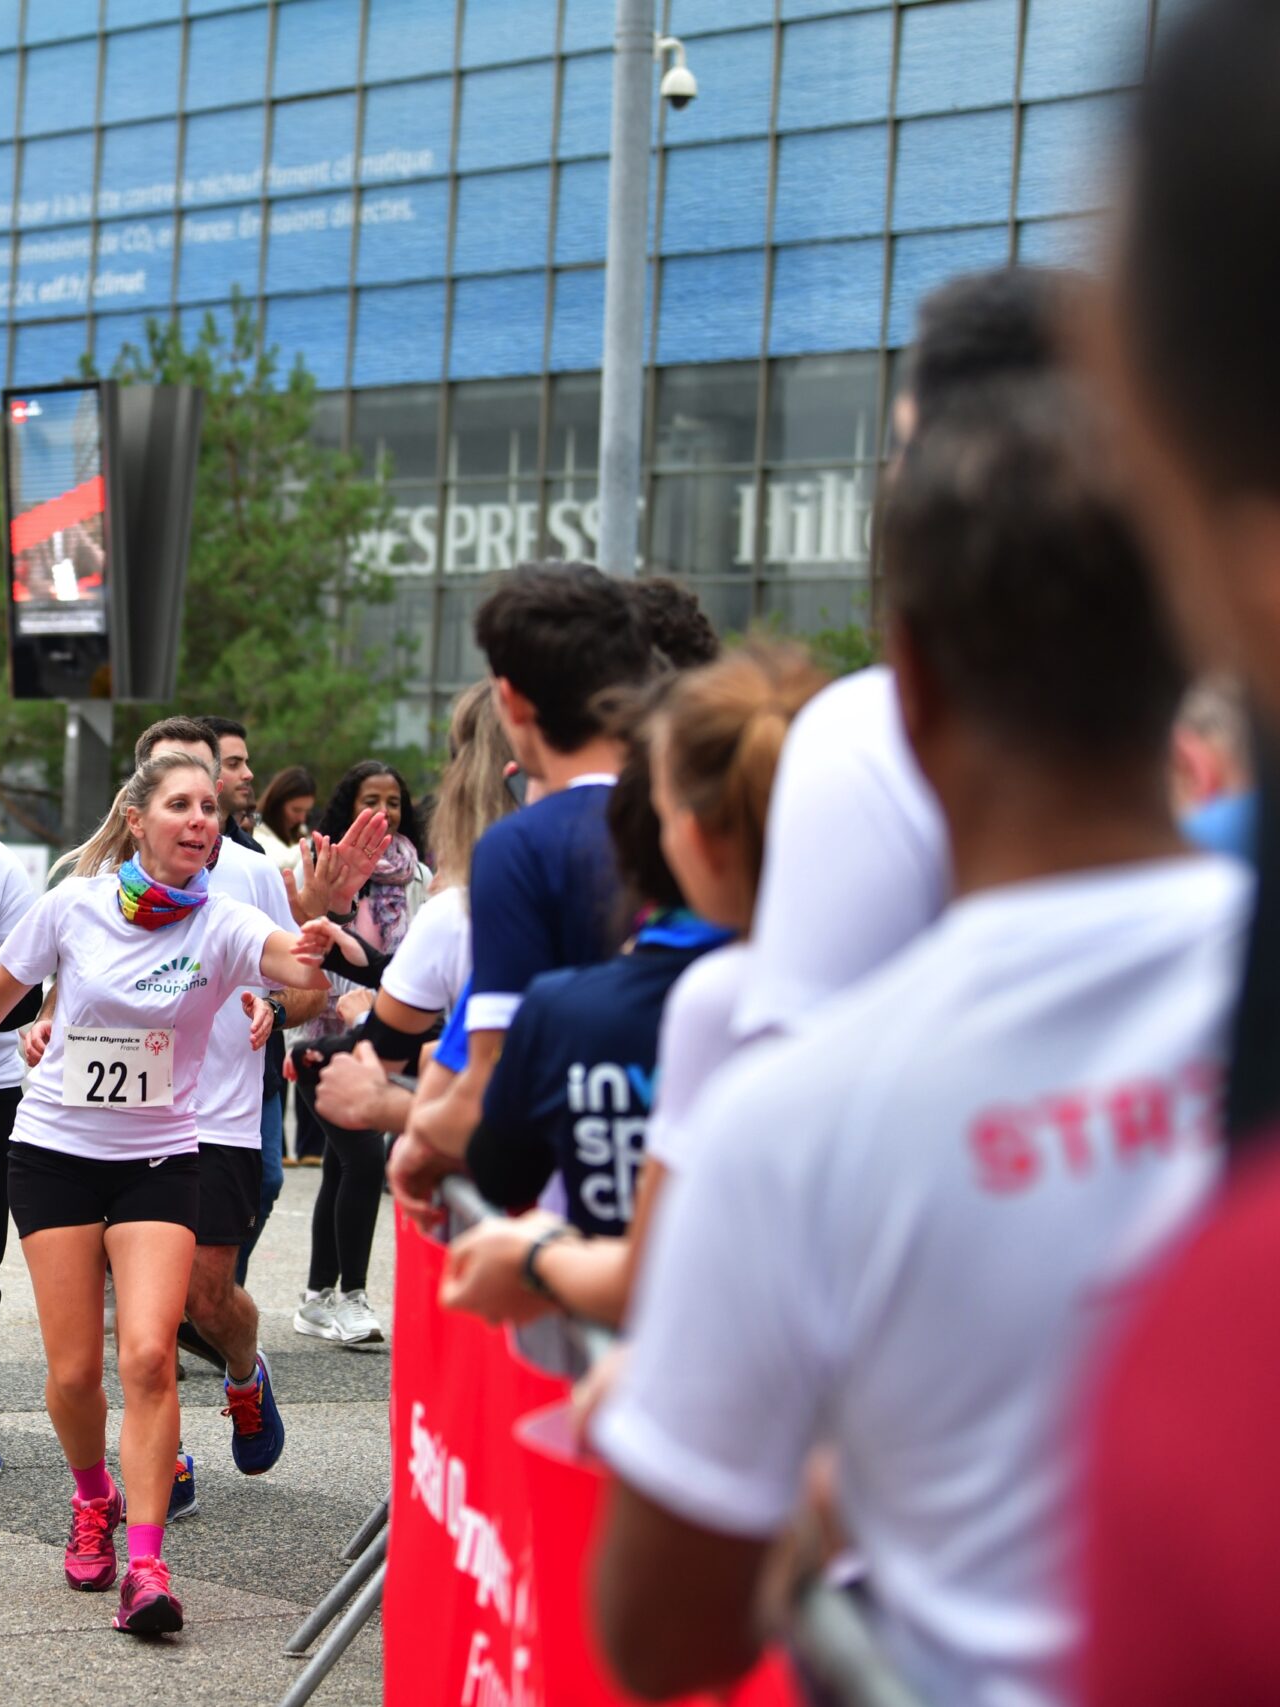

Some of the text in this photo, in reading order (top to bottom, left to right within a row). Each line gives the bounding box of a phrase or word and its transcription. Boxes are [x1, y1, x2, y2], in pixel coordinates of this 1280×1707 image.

[734, 472, 873, 564] Hilt
[135, 977, 208, 997] Groupama
[67, 1034, 140, 1044] Special Olympics
